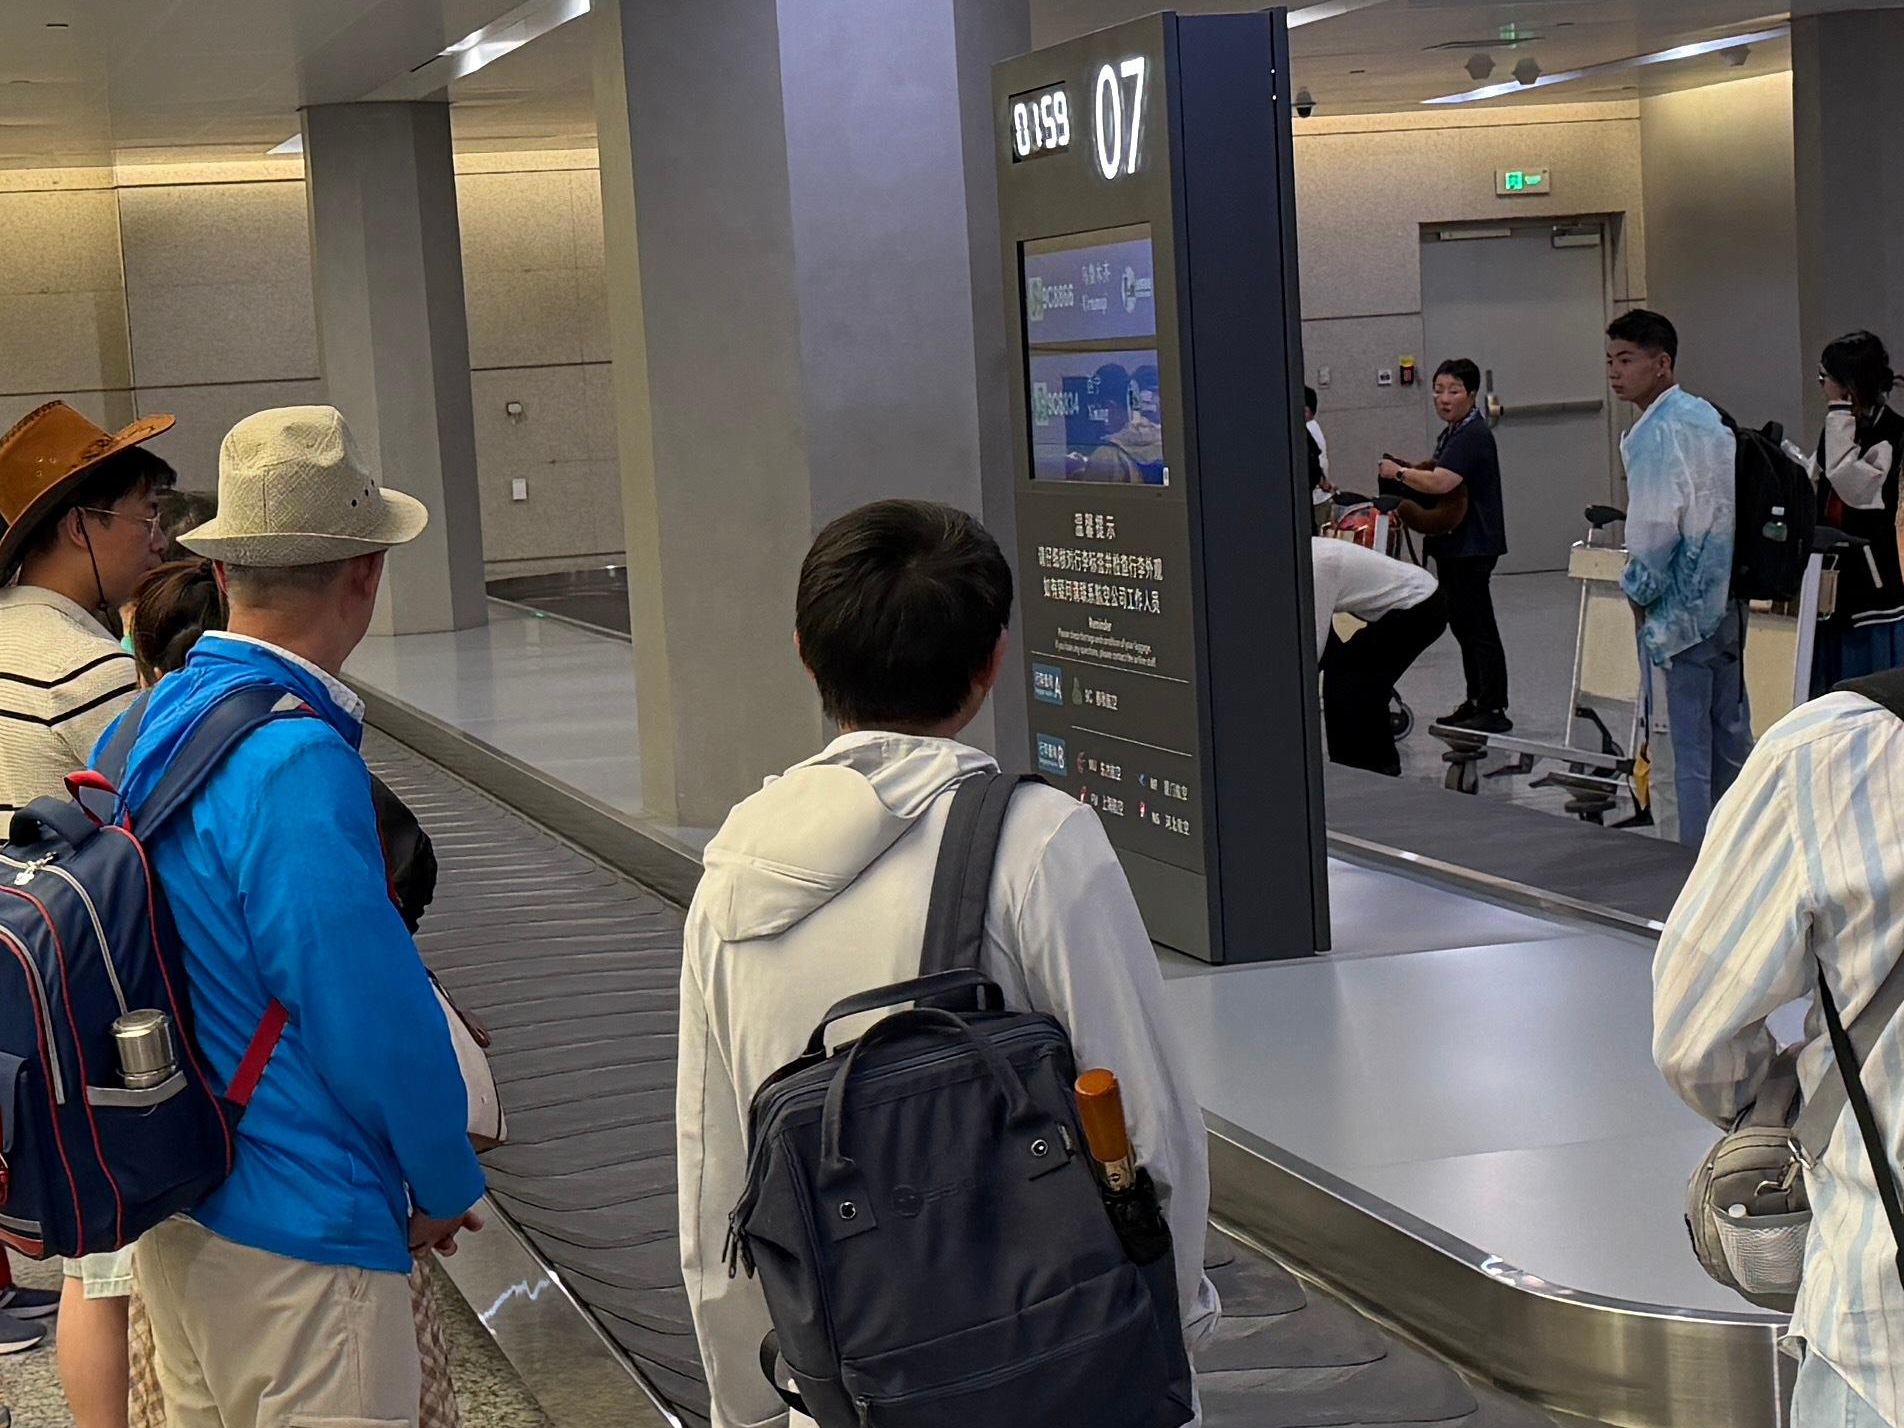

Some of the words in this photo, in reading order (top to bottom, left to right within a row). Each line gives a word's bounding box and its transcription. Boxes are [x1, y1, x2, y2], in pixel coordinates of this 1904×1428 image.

[1096, 57, 1145, 179] 07
[1074, 513, 1116, 540] 温馨提示
